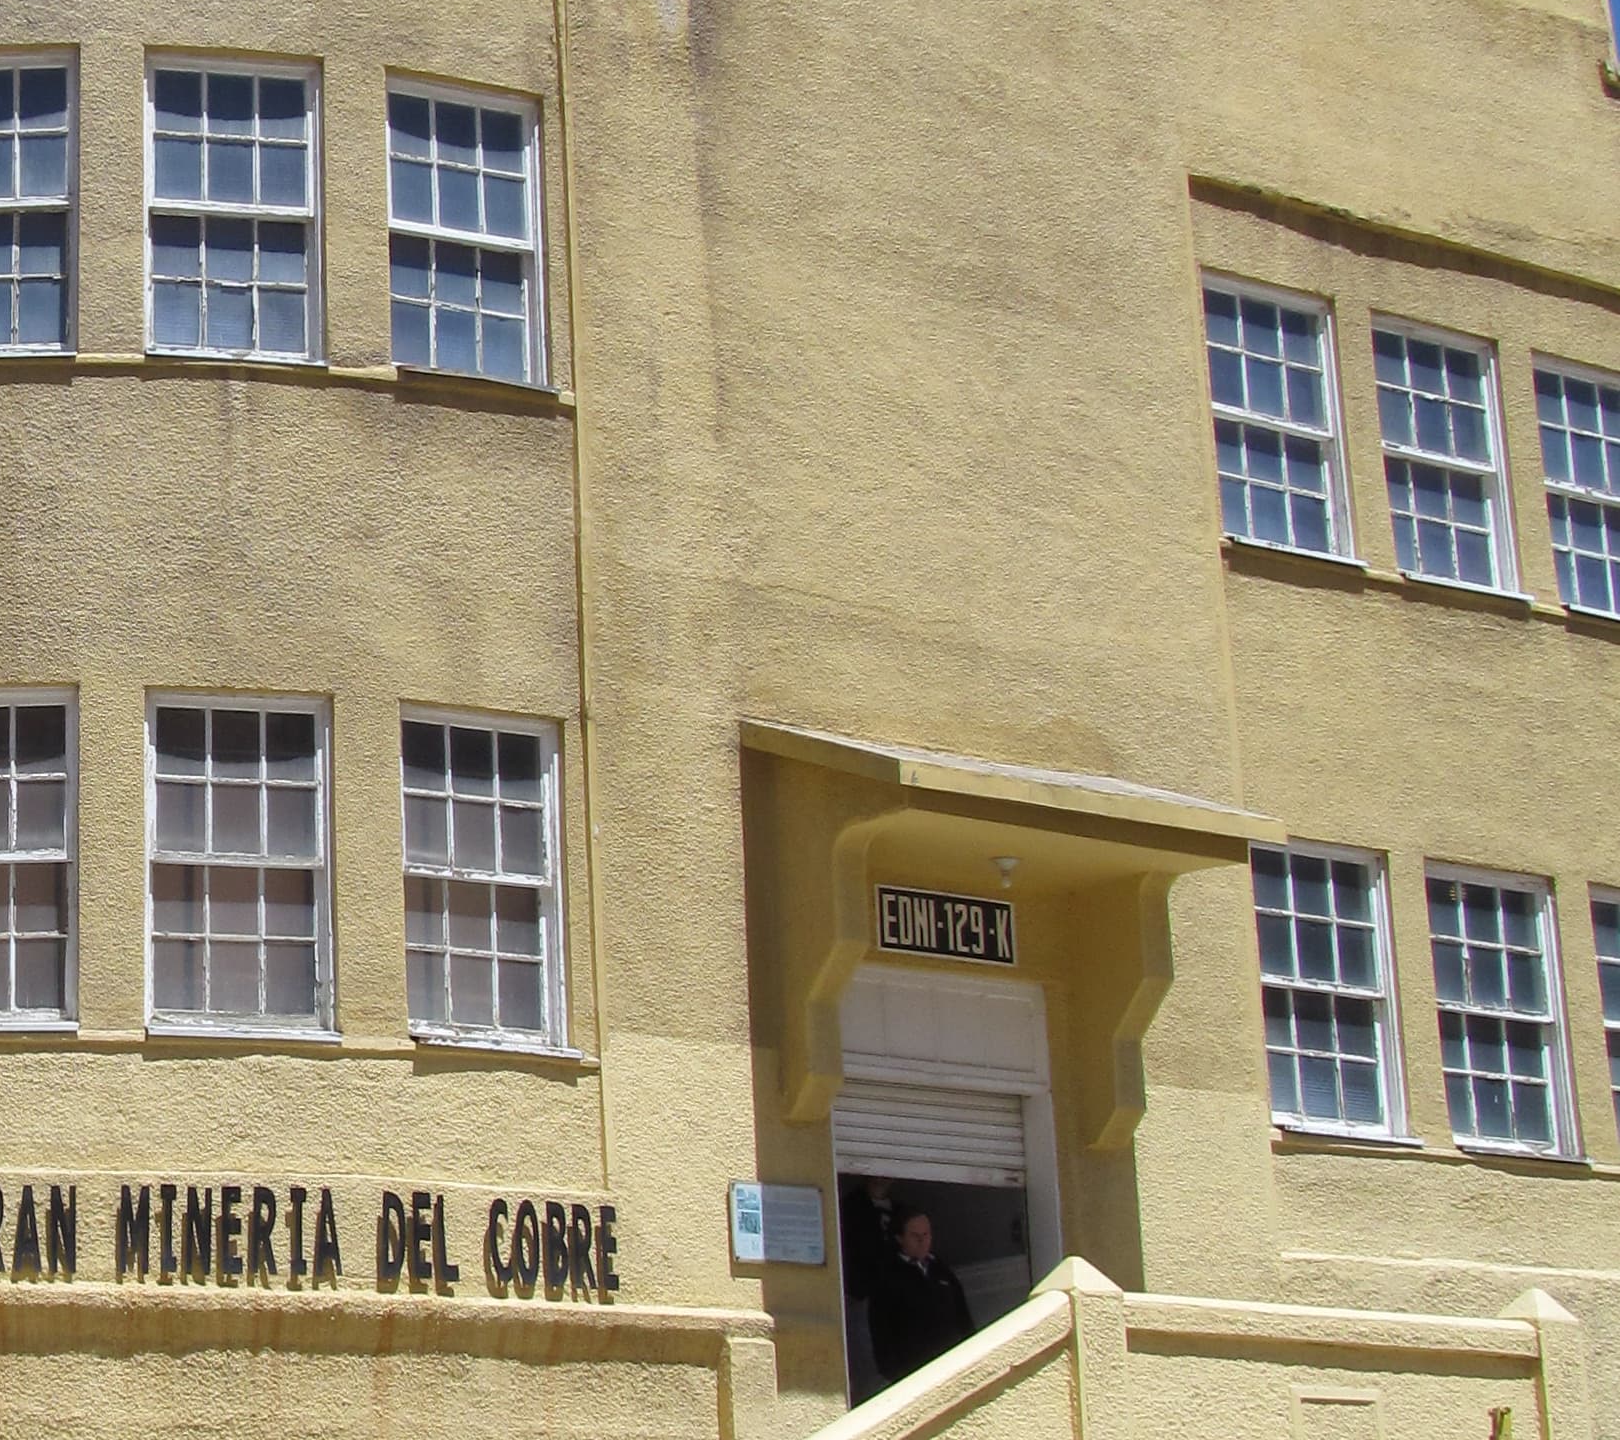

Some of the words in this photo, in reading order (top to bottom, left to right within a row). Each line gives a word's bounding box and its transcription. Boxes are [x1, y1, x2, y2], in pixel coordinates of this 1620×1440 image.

[118, 1184, 342, 1276] MINERIA
[381, 1191, 460, 1282] DEL
[487, 1198, 620, 1291] COBRE
